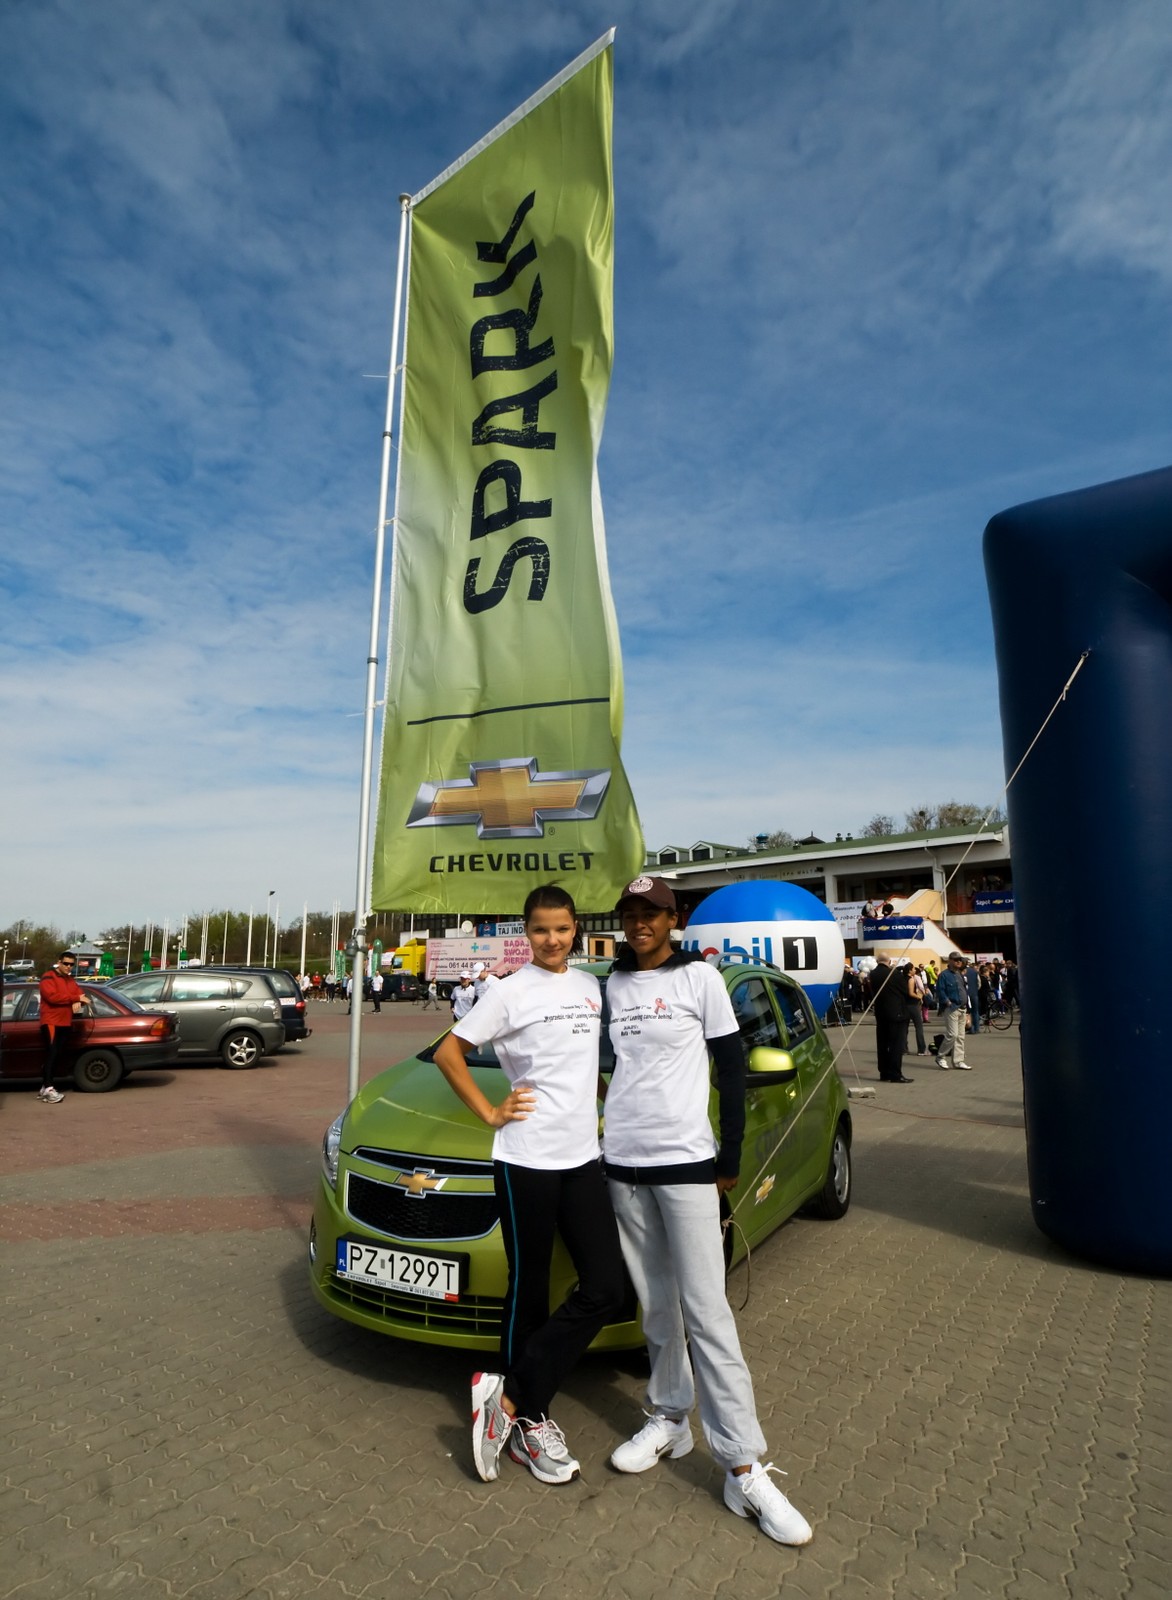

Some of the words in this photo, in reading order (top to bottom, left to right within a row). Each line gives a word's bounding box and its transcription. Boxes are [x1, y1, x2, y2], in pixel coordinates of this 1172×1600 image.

[463, 190, 558, 614] SPARK
[429, 851, 595, 873] CHEVROLET
[498, 927, 509, 935] TAJ
[792, 938, 806, 968] 1
[339, 1258, 346, 1267] PL
[350, 1245, 378, 1276] PZ
[388, 1253, 455, 1290] 1299T
